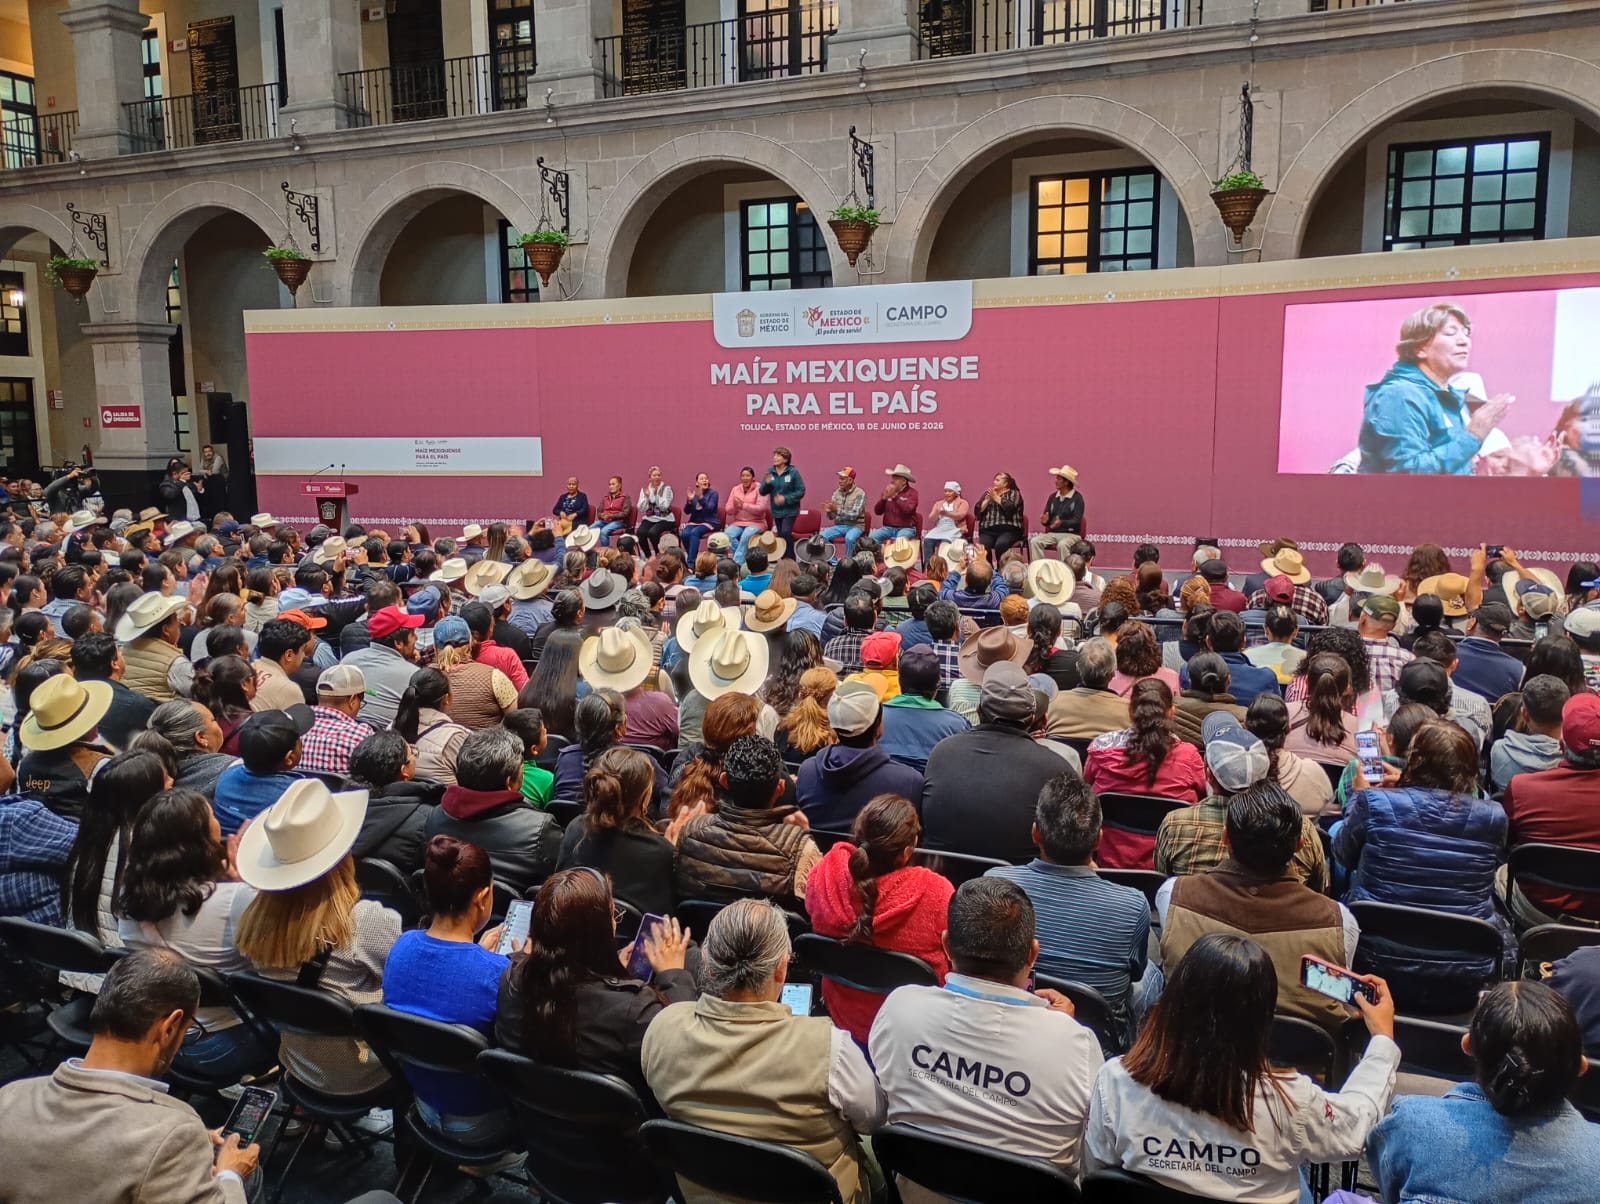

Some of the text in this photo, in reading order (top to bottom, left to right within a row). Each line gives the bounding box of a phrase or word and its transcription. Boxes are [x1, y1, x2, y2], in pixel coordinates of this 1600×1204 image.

[886, 304, 948, 321] CAMPO
[760, 323, 790, 332] MÉXICO
[711, 355, 979, 385] MAÍZ MEXIQUENSE
[746, 384, 938, 415] PARA EL PAÍS
[740, 421, 944, 432] TOLUCA, ESTADO DE MÉXICO, 18 DE JUNIO DE 2026
[26, 774, 51, 792] Jeep
[911, 1044, 1031, 1097] CAMPO
[962, 1086, 980, 1098] DEL
[982, 1091, 1018, 1107] CAMPO
[1143, 1136, 1261, 1167] CAMPO
[1148, 1158, 1257, 1177] SECRETARÍA DEL CAMPO
